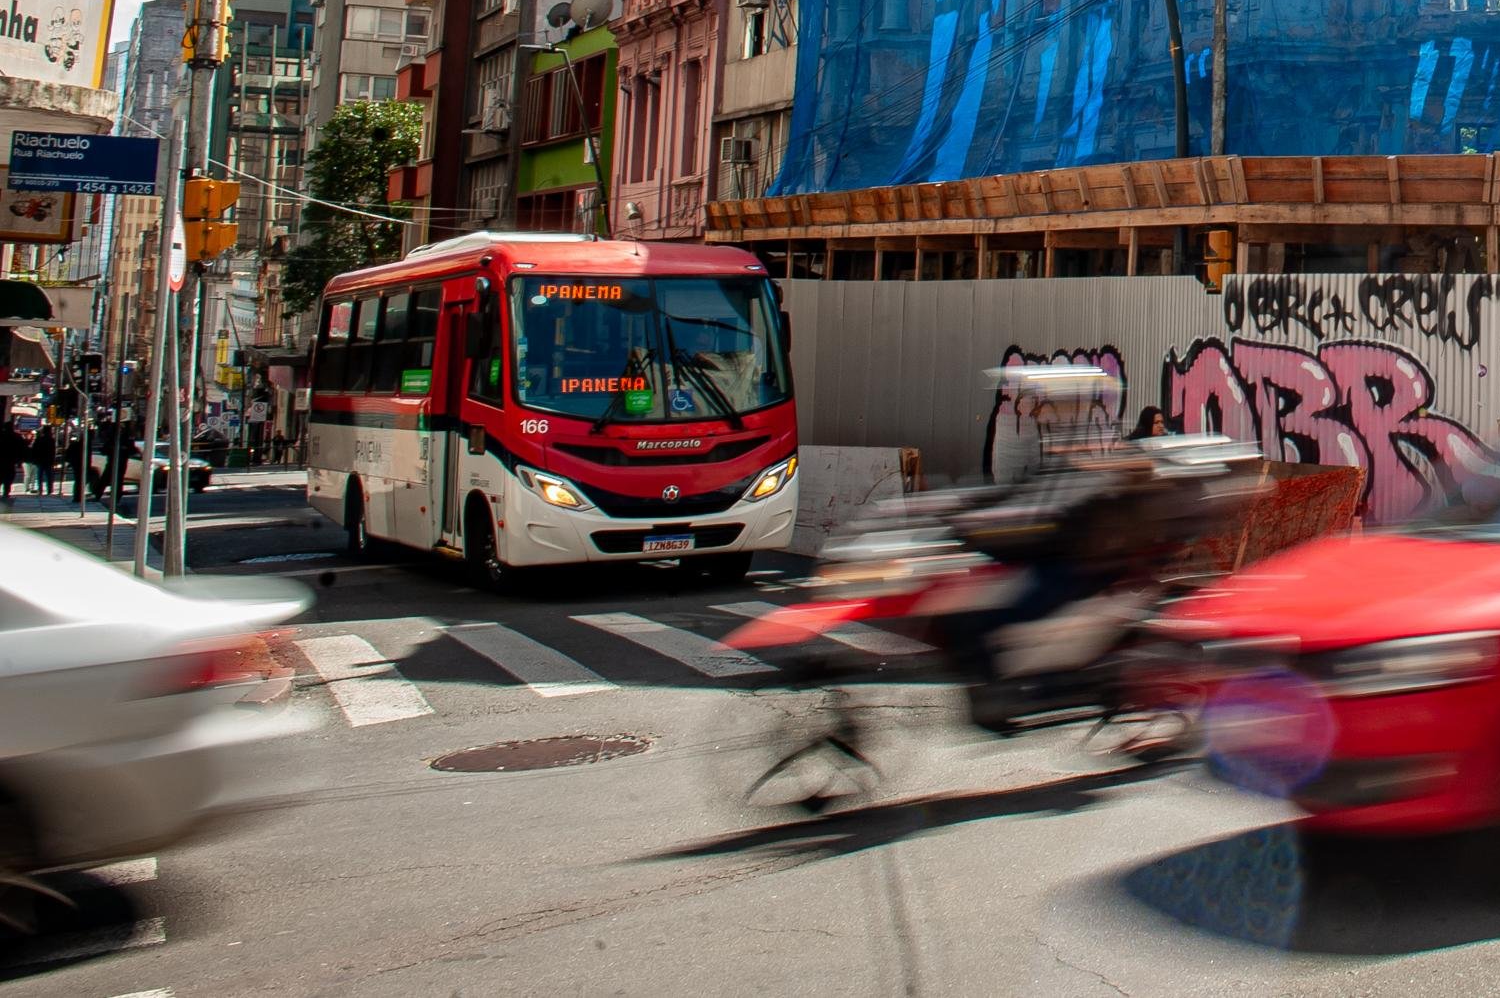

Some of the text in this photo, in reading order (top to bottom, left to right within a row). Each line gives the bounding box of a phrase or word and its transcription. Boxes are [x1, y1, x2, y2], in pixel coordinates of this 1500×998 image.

[15, 133, 90, 149] Riachuelo
[13, 148, 84, 160] Rua Riachuelo
[76, 181, 152, 195] 1454 a 1426
[539, 284, 622, 300] IPANEMA
[561, 377, 645, 393] IPANEMA
[520, 419, 548, 434] 166
[636, 438, 701, 450] Marcopolo
